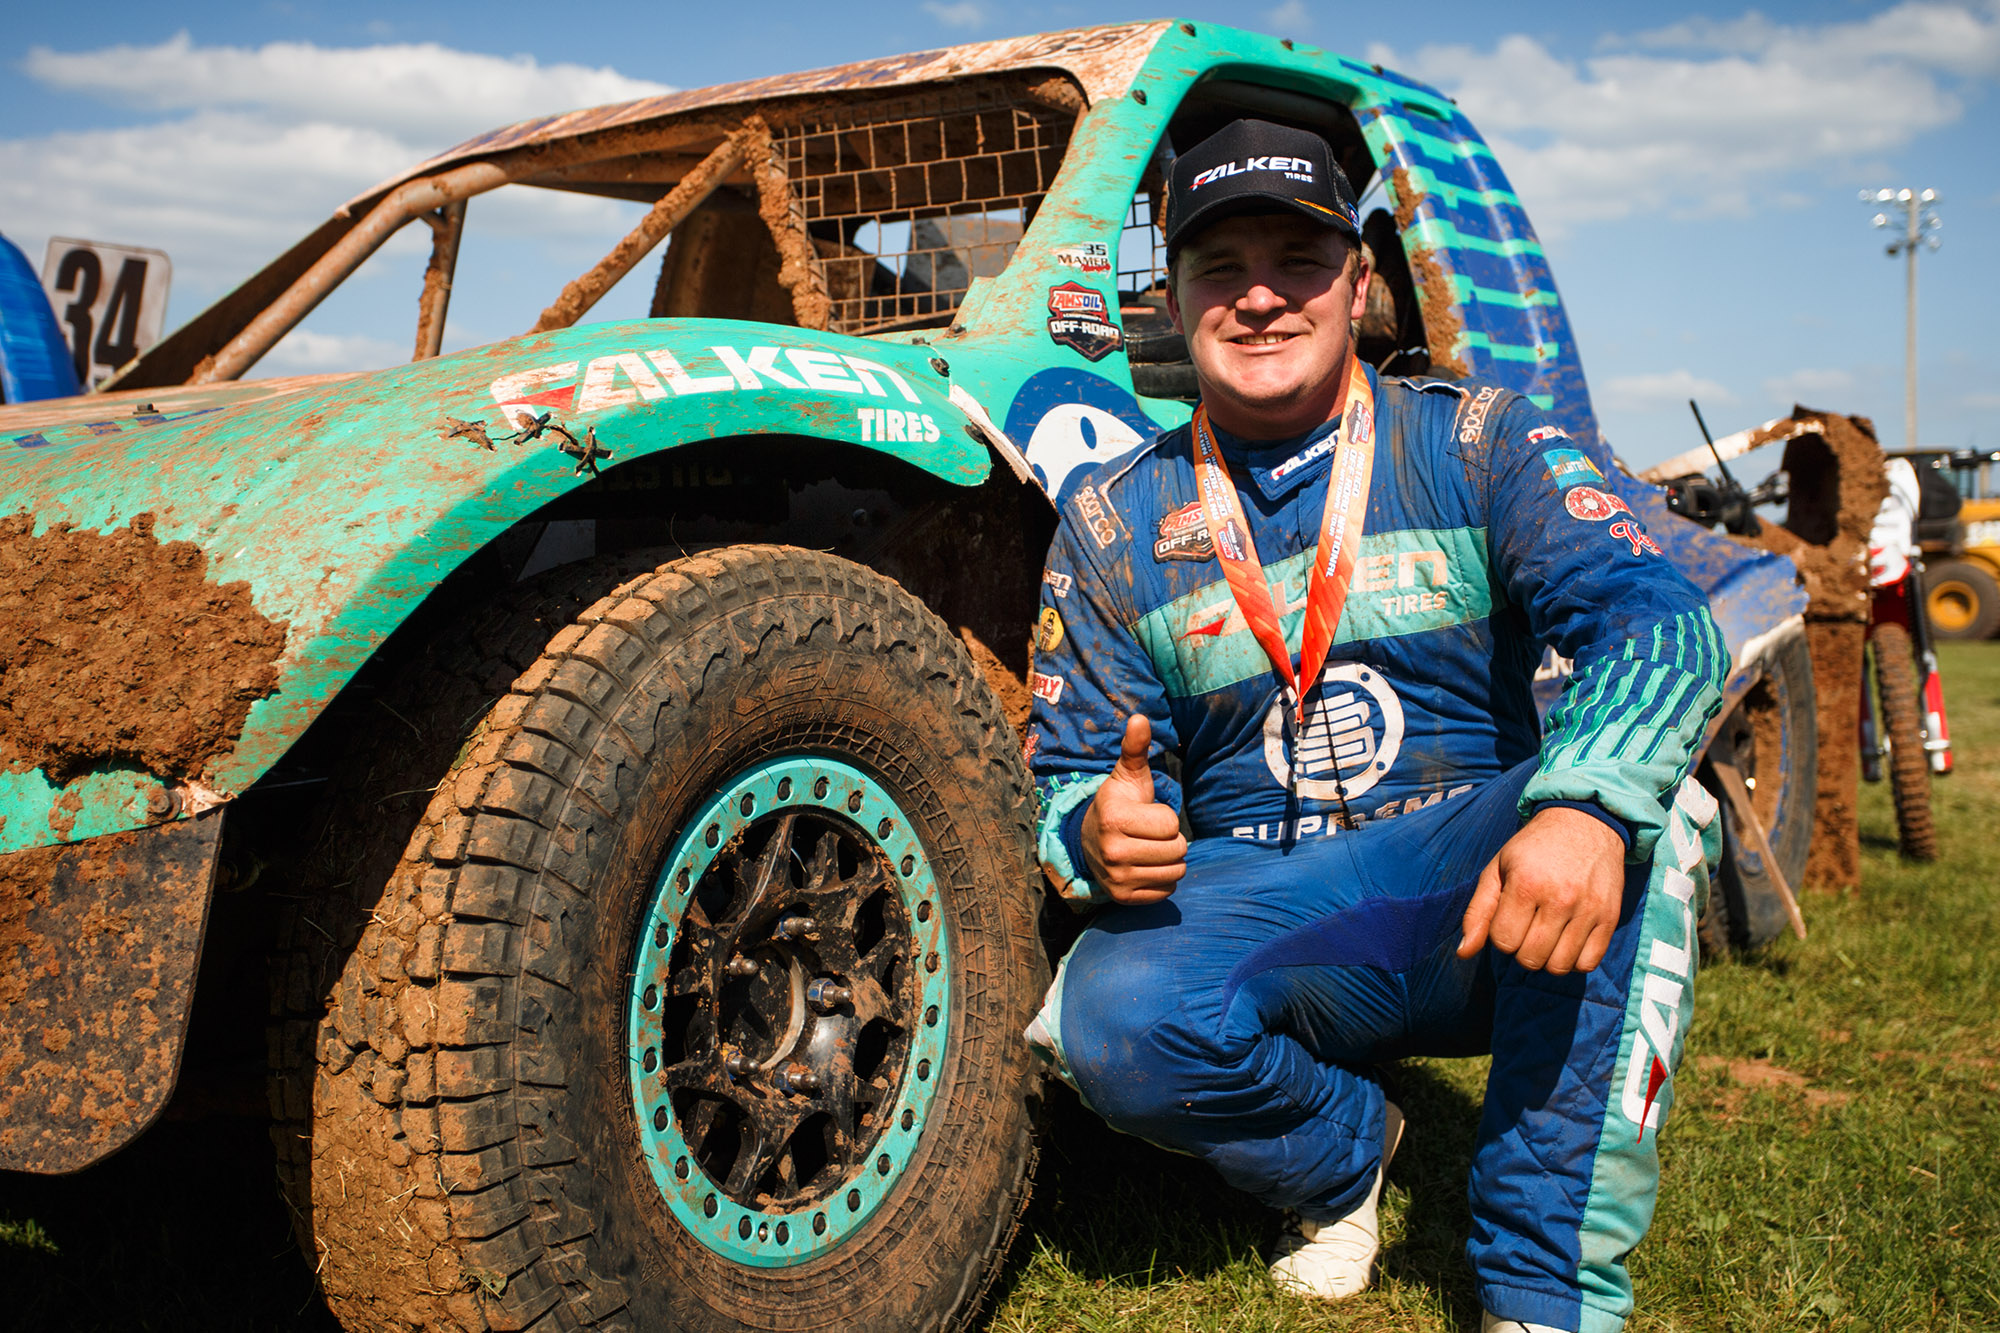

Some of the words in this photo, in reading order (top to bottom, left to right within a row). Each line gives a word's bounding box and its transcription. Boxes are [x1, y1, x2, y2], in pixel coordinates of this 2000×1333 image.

[1189, 156, 1313, 191] FALKEN
[1284, 172, 1313, 183] TIRES
[1084, 243, 1107, 256] 35
[1051, 293, 1101, 309] AMSOIL
[55, 248, 148, 386] 34
[1050, 320, 1119, 339] OFF-ROAD
[486, 345, 922, 432] FALKEN
[857, 407, 941, 443] TIRES
[1159, 529, 1211, 554] OFF-R
[1326, 514, 1347, 579] NATIONAL
[1380, 590, 1448, 617] TIRES
